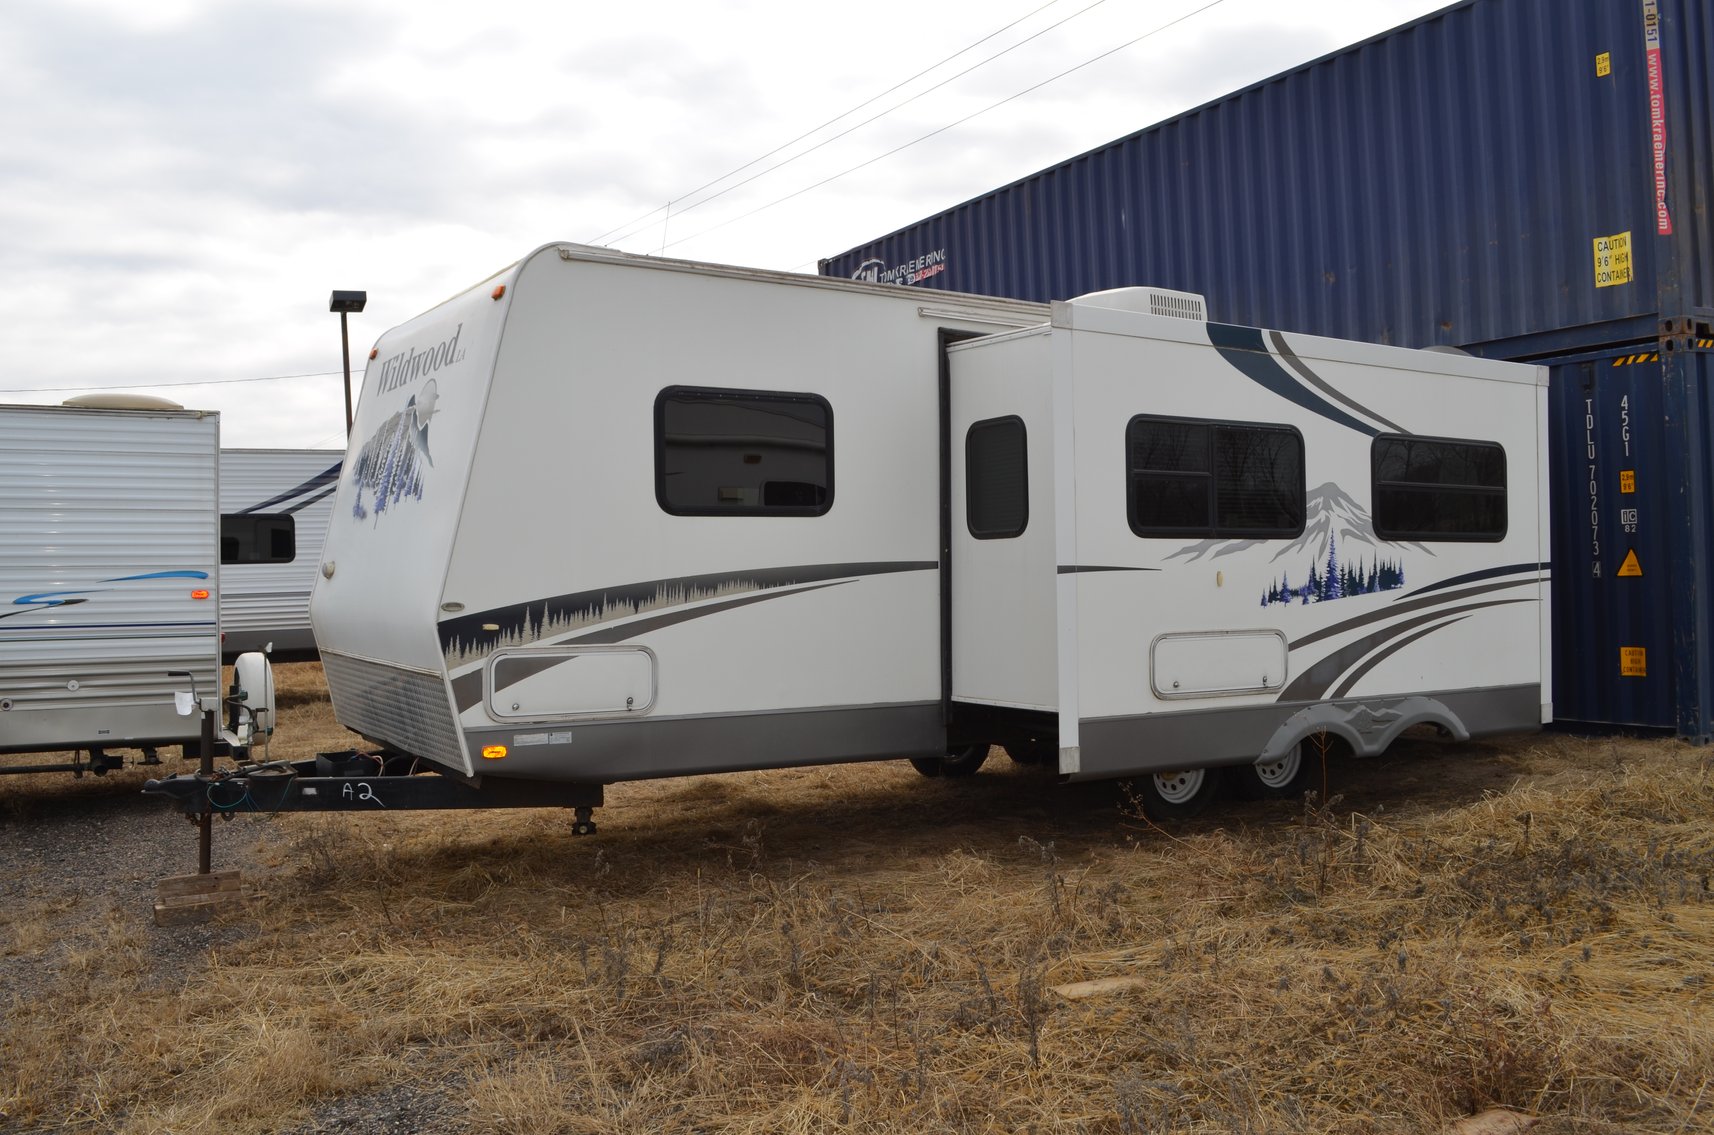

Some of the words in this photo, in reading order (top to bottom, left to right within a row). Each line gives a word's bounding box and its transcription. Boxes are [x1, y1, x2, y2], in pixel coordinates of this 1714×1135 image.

[1648, 53, 1667, 230] www.tomkraemerinc.com
[1597, 236, 1627, 252] CAUTION
[377, 322, 463, 397] Wildwood
[1585, 398, 1596, 460] TDLU
[1620, 394, 1630, 457] 45G1
[1588, 464, 1600, 556] 702073
[1625, 524, 1637, 533] 82
